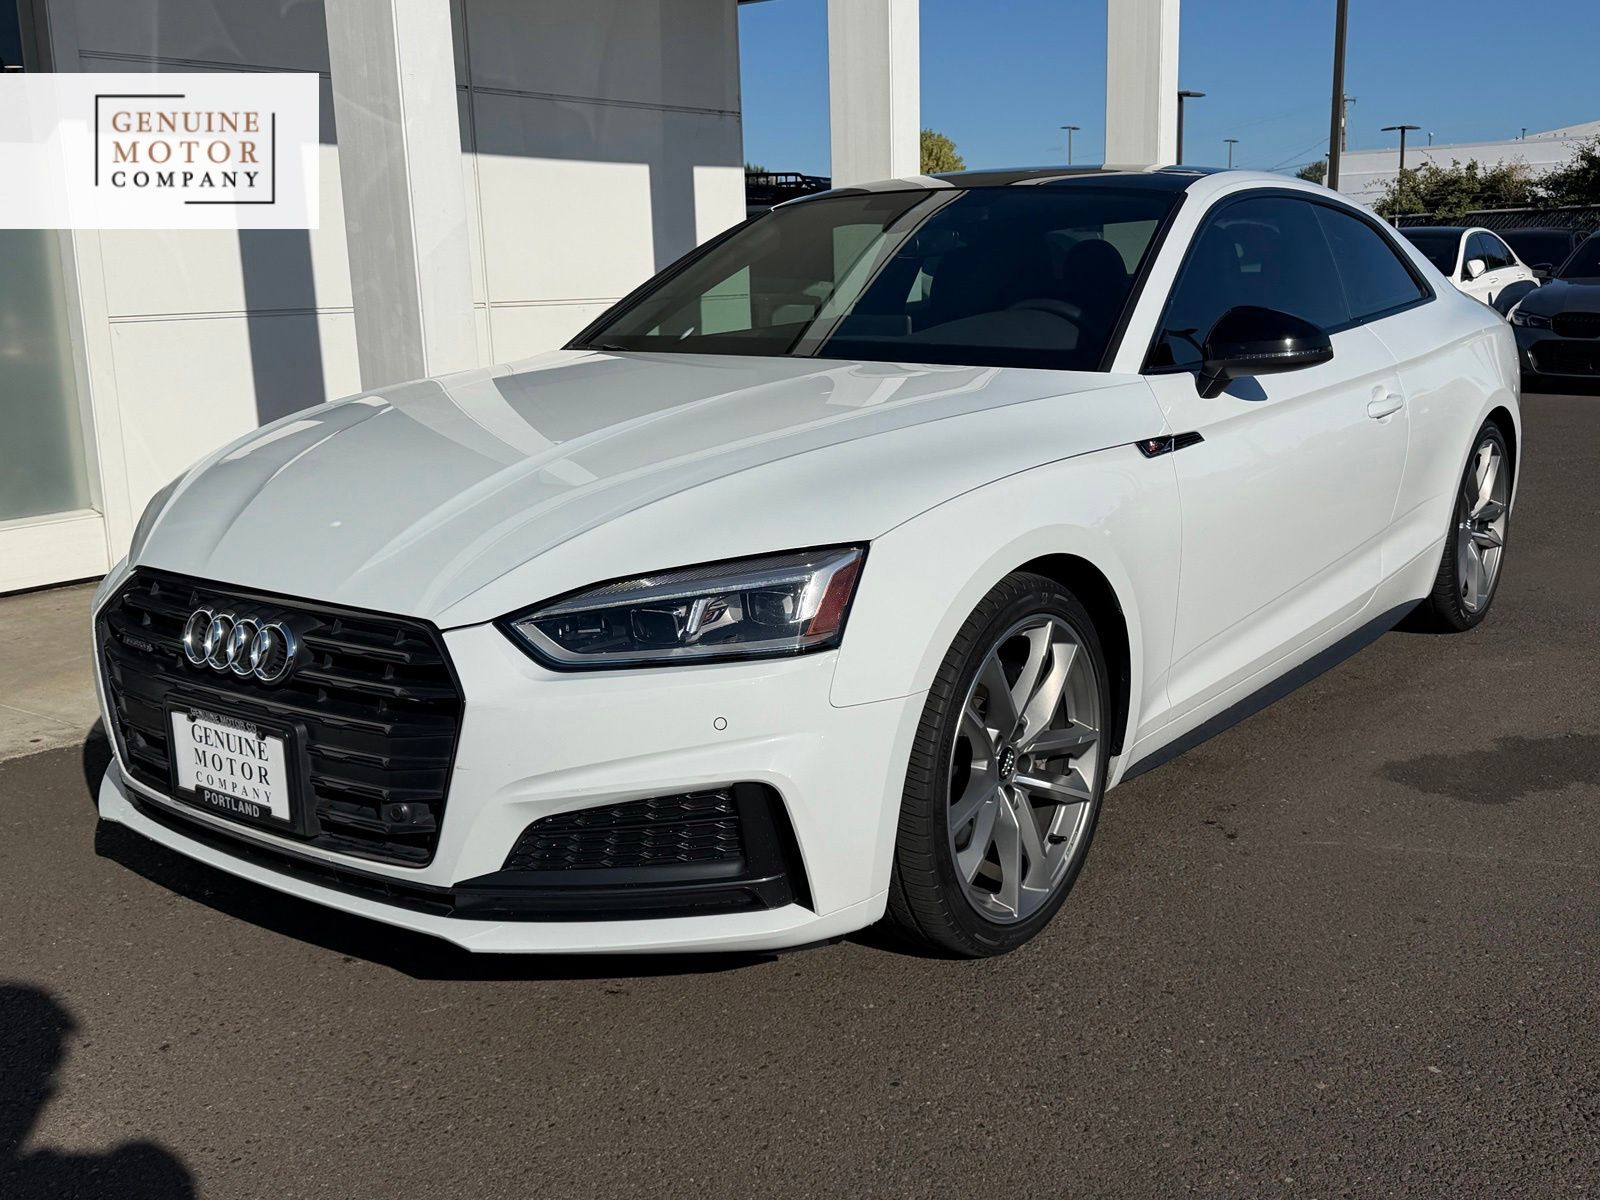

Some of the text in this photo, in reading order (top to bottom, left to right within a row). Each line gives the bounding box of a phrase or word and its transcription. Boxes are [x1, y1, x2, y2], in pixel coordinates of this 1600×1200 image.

[191, 723, 269, 762] GENUINE
[193, 747, 271, 786] MOTOR
[196, 770, 272, 803] COMPANY
[204, 790, 260, 817] PORTLAND
